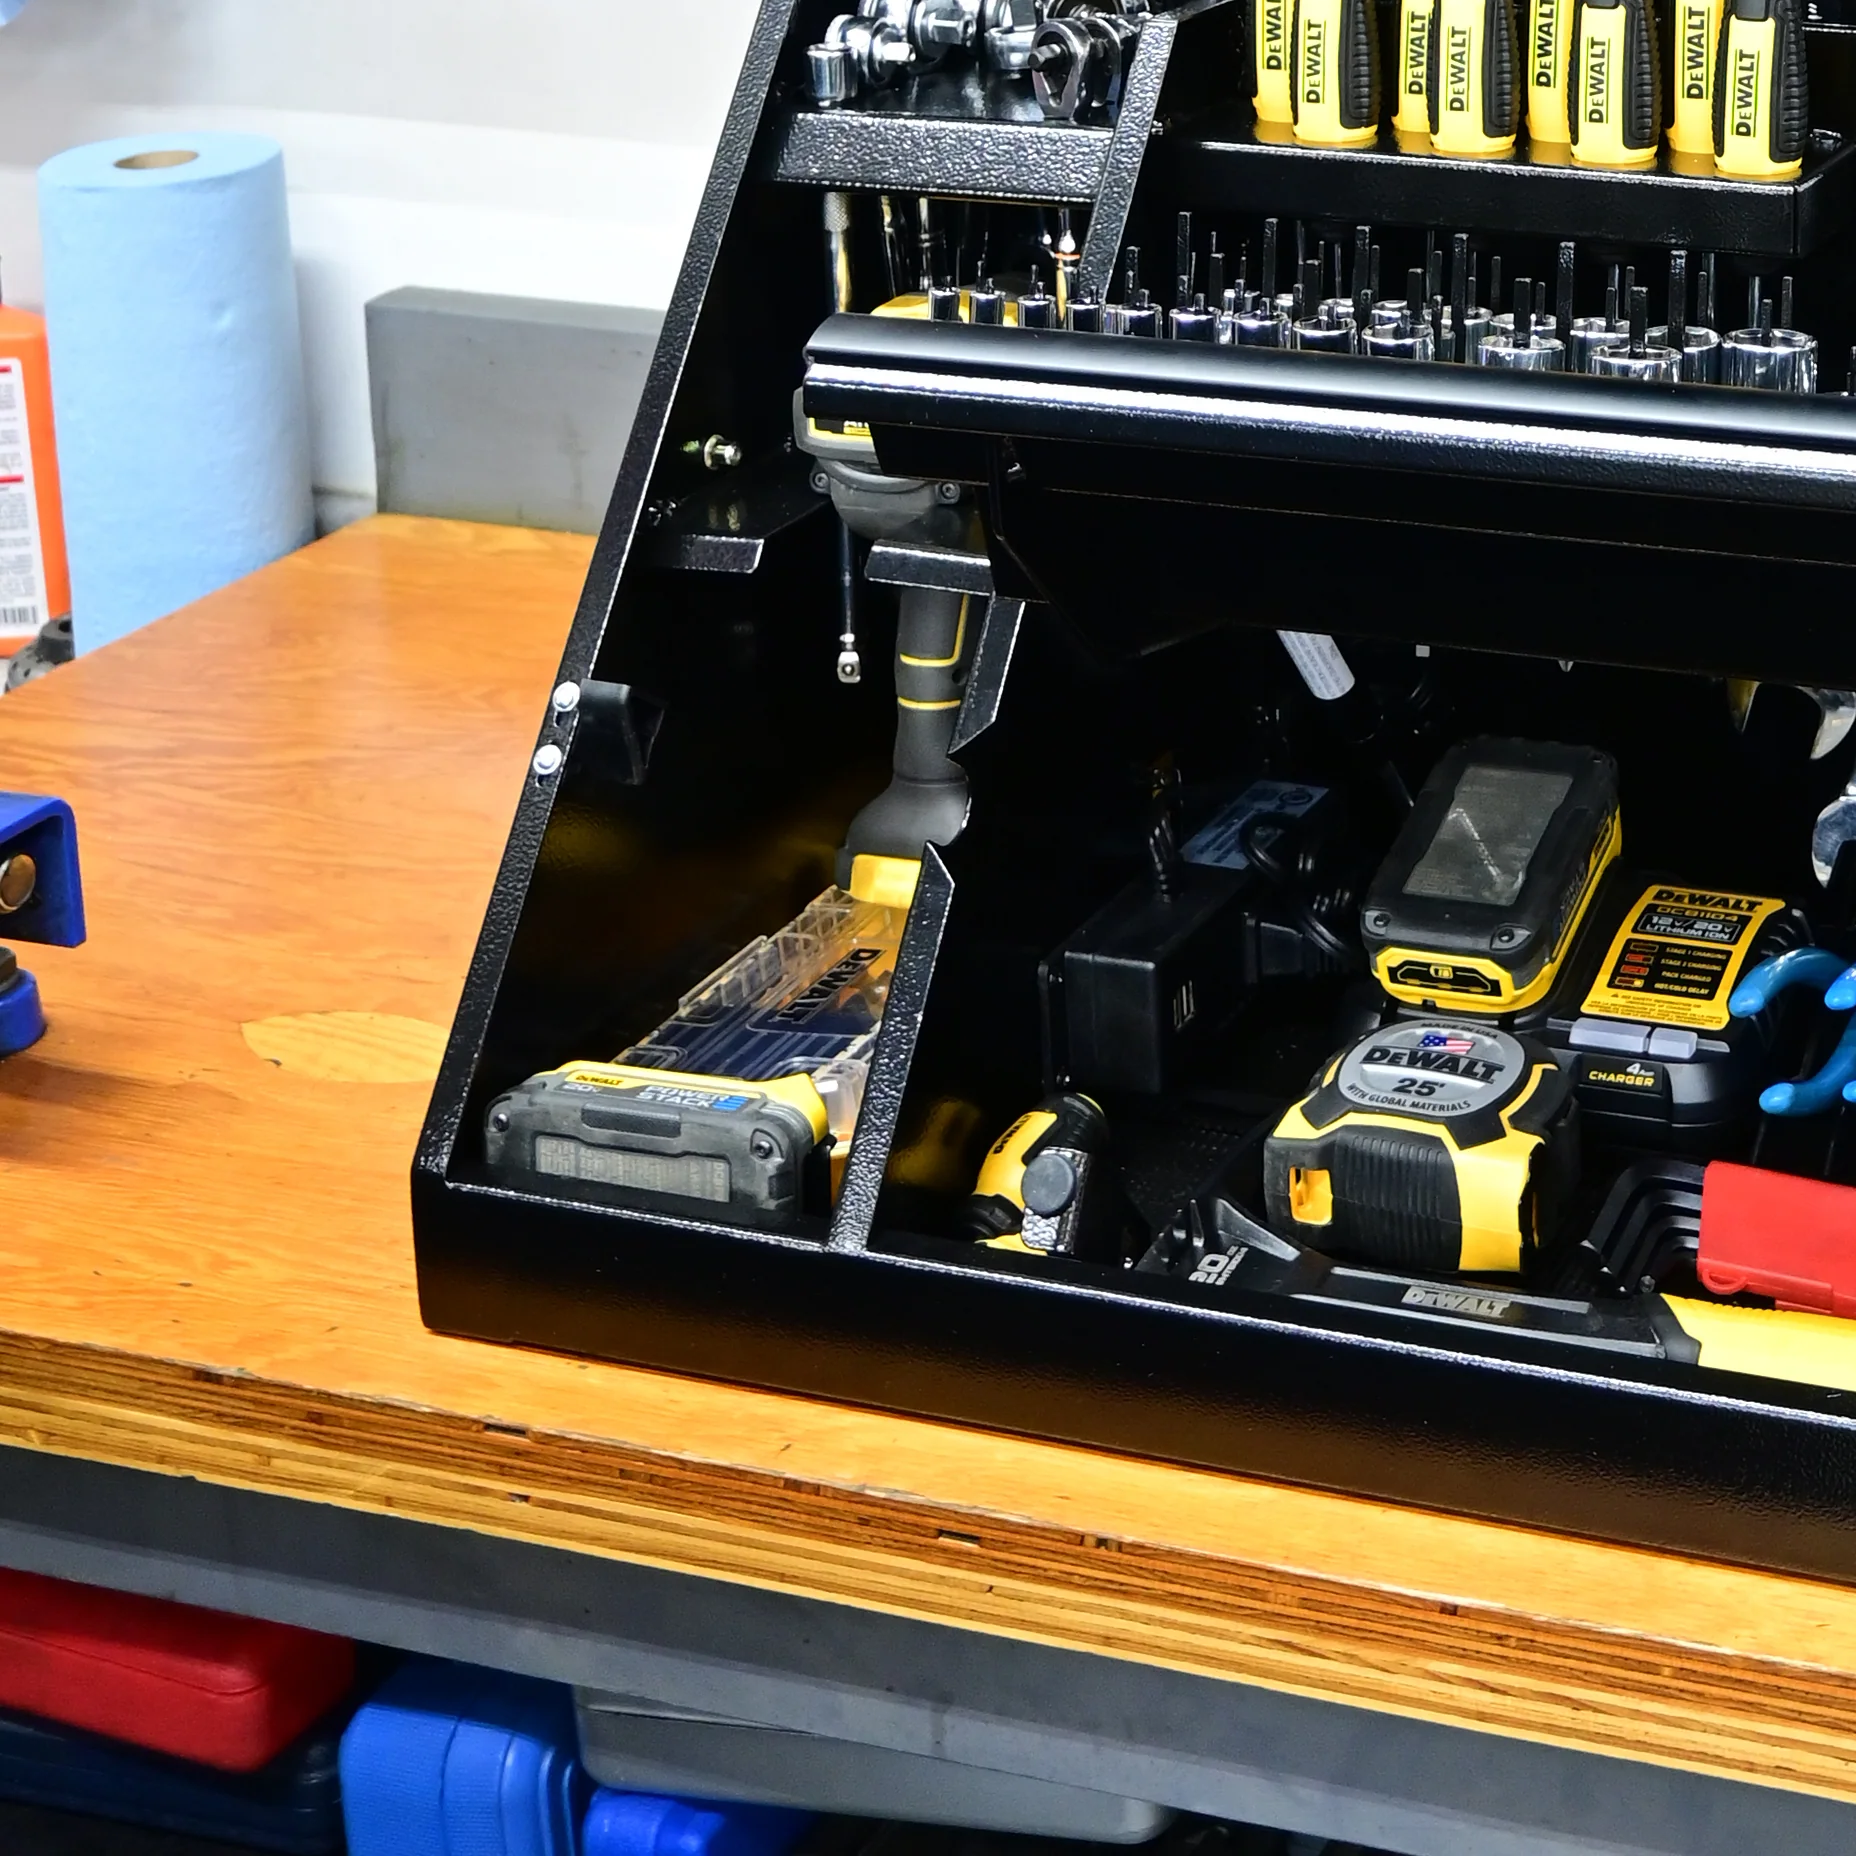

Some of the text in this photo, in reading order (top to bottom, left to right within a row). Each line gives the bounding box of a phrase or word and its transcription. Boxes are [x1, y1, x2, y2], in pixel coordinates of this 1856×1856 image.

[1305, 19, 1324, 105] DEWALT
[1408, 12, 1428, 96] DEWALT
[1686, 7, 1707, 100] DEWALT
[1449, 26, 1468, 112] DEWALT
[1588, 37, 1608, 124] DEWALT
[1736, 49, 1756, 137] DEWALT
[1652, 888, 1764, 913] DEWALT
[1656, 906, 1739, 923] DCB1104
[1646, 924, 1731, 941] LITHIUM ION
[1660, 958, 1682, 967] STAGE
[1661, 970, 1712, 983] PACK CHARGED
[779, 947, 885, 1025] DEWALT
[1688, 987, 1711, 996] DELAY
[1475, 1028, 1498, 1038] USA
[1361, 1047, 1504, 1083] DEWALT
[1625, 1062, 1642, 1075] 4
[575, 1074, 625, 1086] DEWALT
[1588, 1070, 1655, 1087] CHARGER
[635, 1091, 714, 1107] STACK
[644, 1085, 731, 1102] POWER
[1368, 1093, 1407, 1108] GLOBAL
[1408, 1100, 1472, 1112] MATERIALS
[1401, 1286, 1512, 1317] DEWALT
